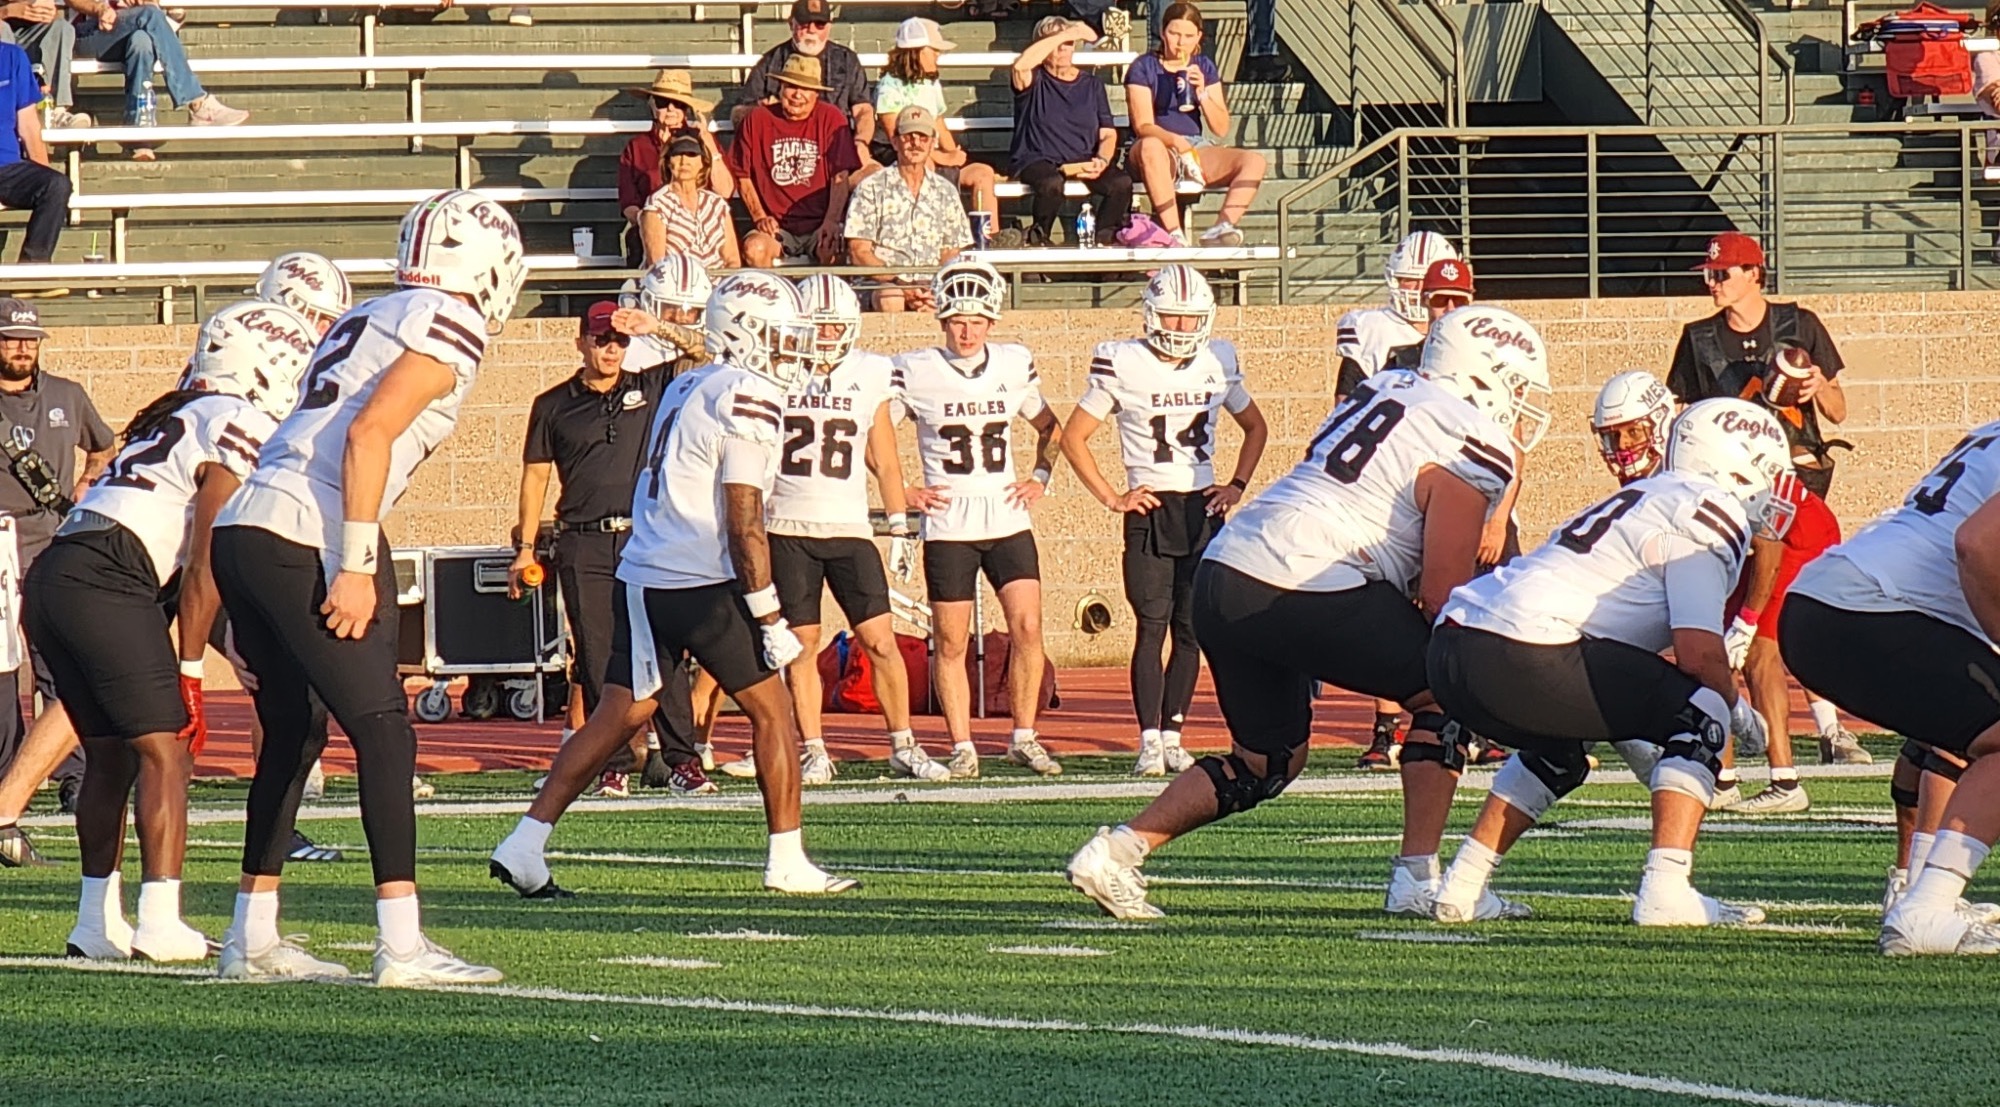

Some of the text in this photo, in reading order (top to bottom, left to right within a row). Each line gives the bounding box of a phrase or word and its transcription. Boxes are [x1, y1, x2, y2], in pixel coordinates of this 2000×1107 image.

[467, 201, 519, 240] Eagl
[234, 309, 309, 355] Eagles
[1463, 317, 1536, 355] Eagles
[787, 394, 852, 411] EAGLES
[943, 400, 1006, 417] EAGLES
[780, 415, 858, 480] 26
[938, 420, 1009, 475] 36
[1148, 409, 1210, 464] 14
[1303, 383, 1406, 484] 78
[1712, 410, 1782, 443] Eagles
